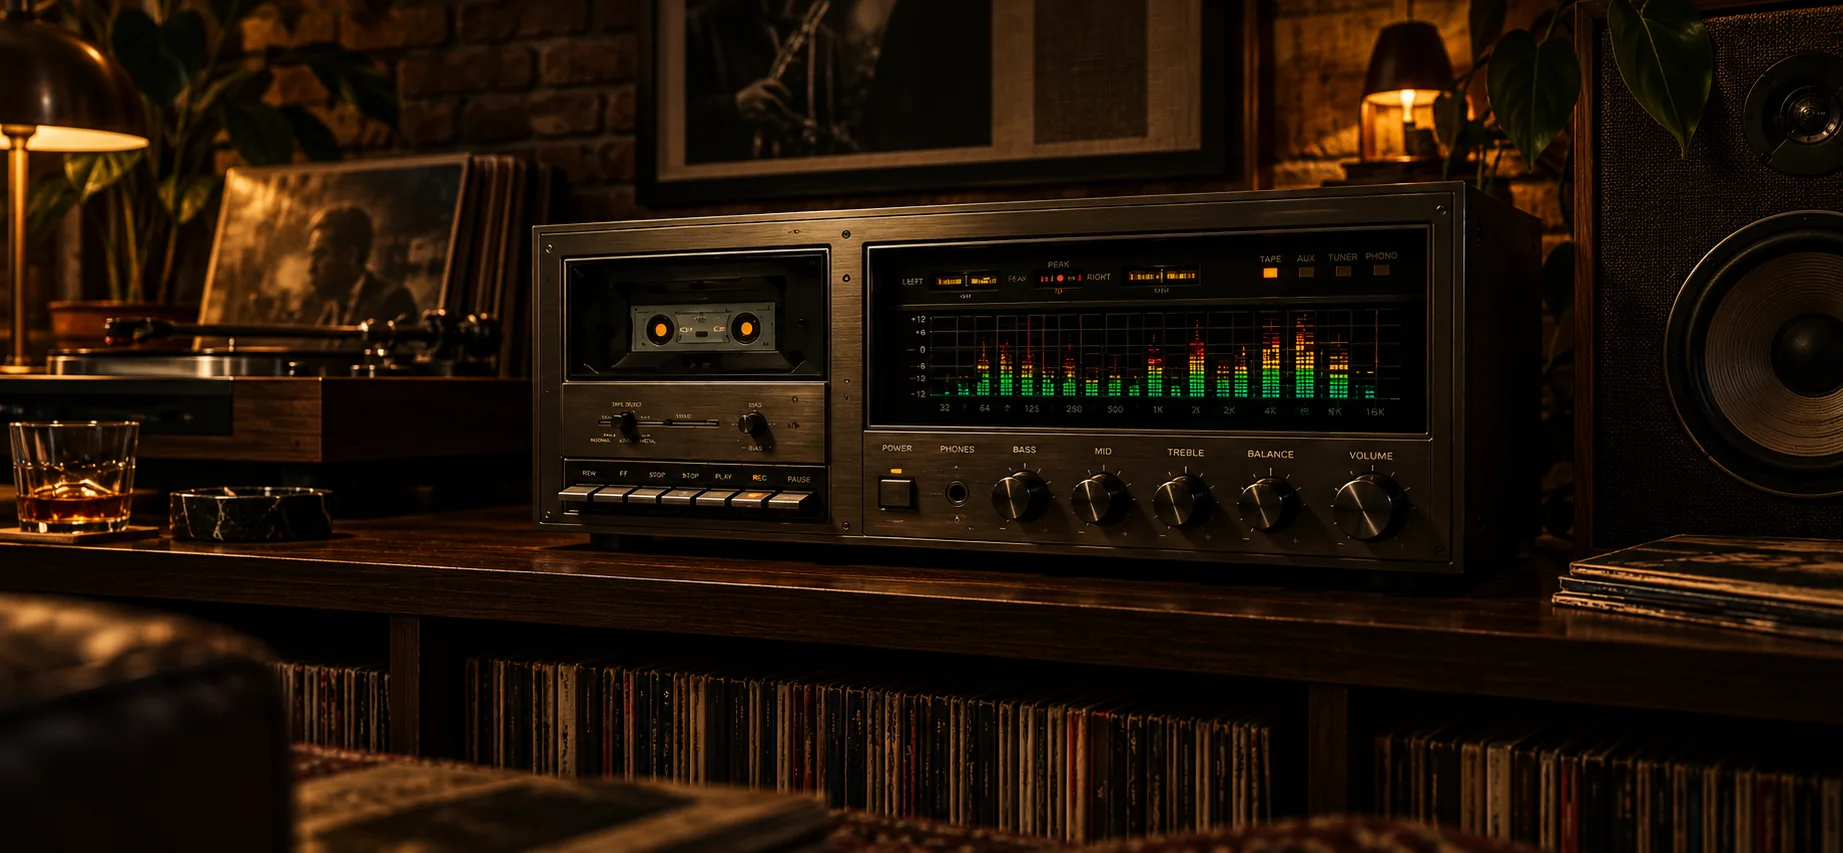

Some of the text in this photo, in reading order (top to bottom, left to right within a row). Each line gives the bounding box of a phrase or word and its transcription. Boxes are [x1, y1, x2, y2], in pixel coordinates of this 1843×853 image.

[1260, 255, 1282, 263] TAPE
[1296, 254, 1316, 262] AUX
[1328, 253, 1358, 262] TUNER
[1365, 251, 1398, 260] PHONO
[1047, 260, 1070, 269] PEAK
[939, 404, 950, 412] 32
[979, 404, 990, 412] 64
[1153, 405, 1164, 414] 1K
[1223, 405, 1236, 415] 2K
[882, 444, 912, 453] POWER
[940, 445, 975, 454] PHONES
[1013, 446, 1037, 455] BASS
[1095, 447, 1113, 456] MID
[1167, 448, 1205, 458] TREBLE
[1247, 450, 1294, 459] BALANCE
[1350, 451, 1394, 461] VOLUME
[714, 473, 733, 481] PLAY
[752, 474, 768, 482] REC
[787, 475, 812, 484] PAUSE
